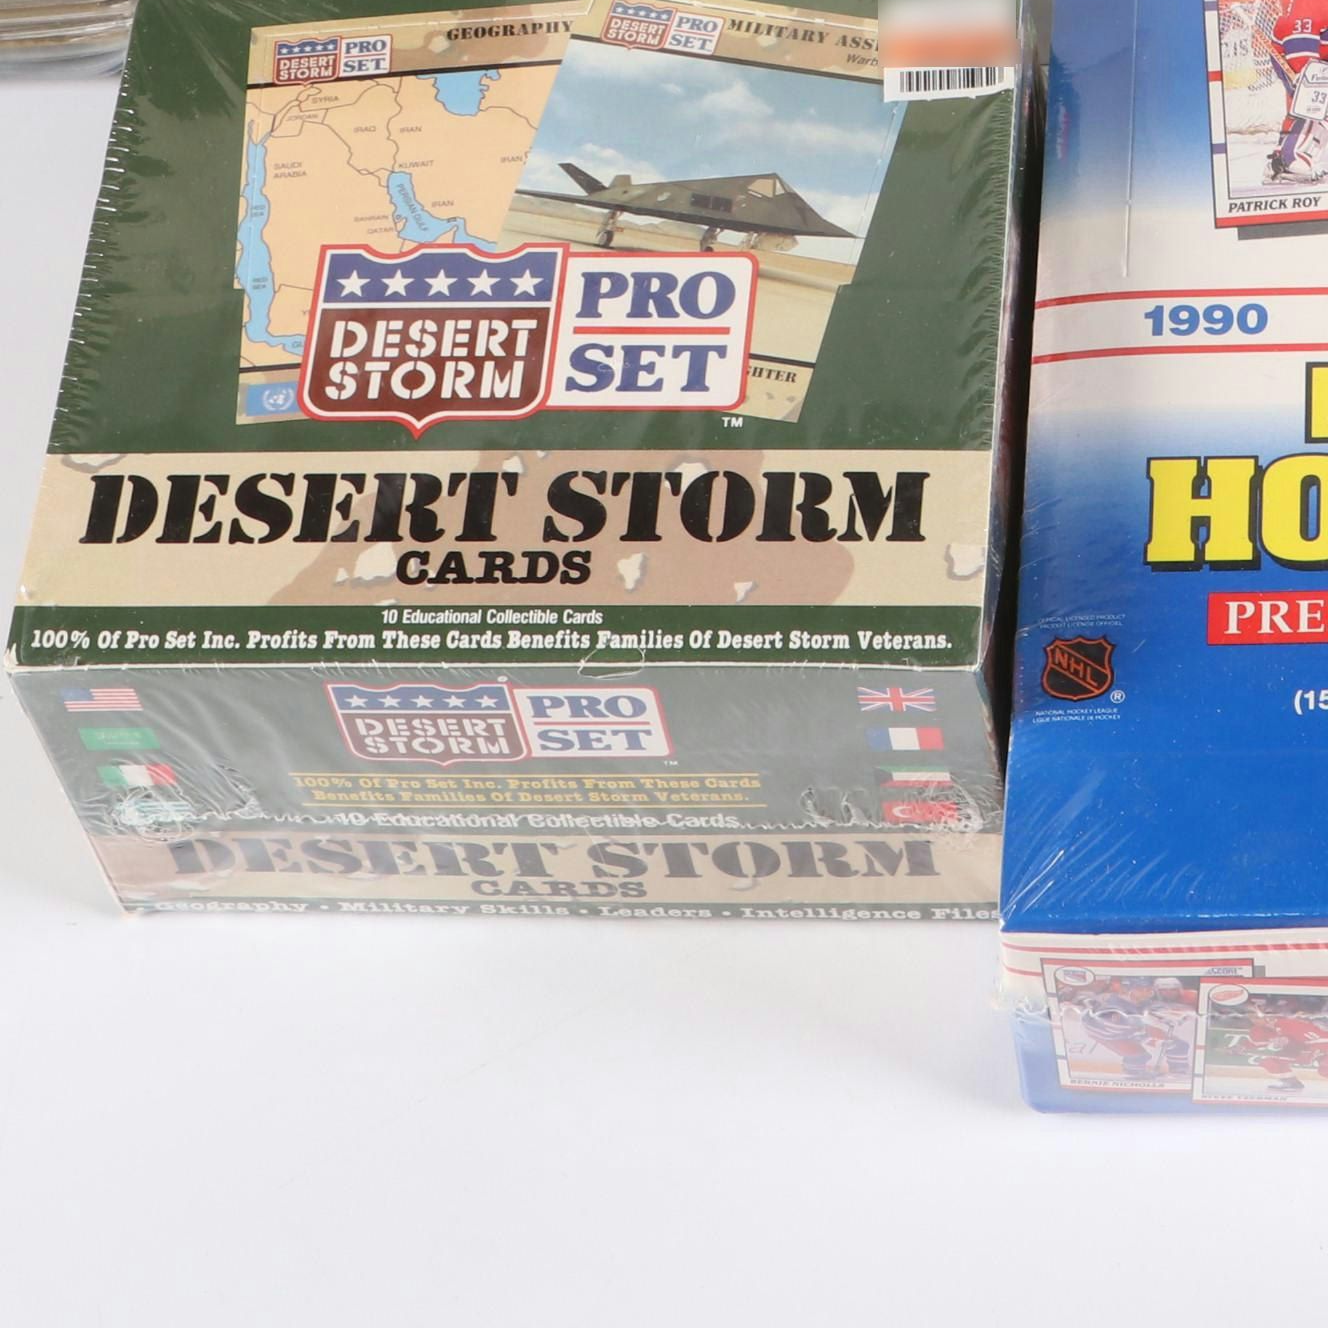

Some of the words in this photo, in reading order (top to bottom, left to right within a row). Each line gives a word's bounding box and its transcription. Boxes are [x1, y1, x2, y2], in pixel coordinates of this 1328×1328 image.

[446, 21, 574, 42] GEOGRAPHY
[609, 17, 667, 39] DESERT
[677, 15, 718, 34] PRO
[728, 19, 830, 46] MILITARY
[1292, 18, 1312, 34] 33
[343, 39, 387, 55] PRO
[607, 27, 660, 47] STORM
[669, 33, 713, 52] SET
[280, 54, 336, 70] DESERT
[342, 58, 386, 73] SET
[279, 66, 333, 81] STORM
[1228, 197, 1291, 214] PATRICK
[1293, 195, 1322, 210] ROY
[574, 271, 737, 321] PRO
[1144, 302, 1270, 337] 1990
[328, 319, 538, 360] DESERT
[565, 342, 729, 394] SET
[323, 359, 525, 402] STORM
[78, 471, 521, 546] DESERT
[542, 469, 932, 544] STORM
[395, 549, 593, 586] CARDS
[381, 610, 398, 626] 10
[402, 608, 482, 626] Educational
[486, 608, 559, 626] Collectible
[563, 609, 603, 626] Cards
[31, 629, 91, 650] 100%
[97, 629, 122, 650] Of
[124, 629, 161, 650] Pro
[164, 629, 197, 650] Set
[202, 629, 242, 650] Inc.
[246, 629, 318, 650] Profits
[322, 629, 376, 650] From
[382, 629, 441, 650] These
[446, 629, 502, 650] Cards
[506, 629, 591, 650] Benefits
[596, 629, 684, 650] Families
[689, 629, 715, 650] Of
[716, 629, 784, 650] Desert
[789, 629, 850, 650] Storm
[857, 629, 954, 650] Veterans.
[1055, 647, 1099, 687] NHL
[526, 694, 648, 719] PRO
[355, 717, 508, 738] DESERT
[363, 735, 512, 756] STORM
[534, 728, 654, 752] SET
[168, 838, 560, 878] DESERT
[586, 840, 942, 879] STORM
[470, 879, 648, 899] CARDS
[338, 901, 476, 916] Military
[480, 903, 569, 916] Skills
[598, 905, 712, 918] Leaders
[740, 906, 922, 921] Intelligence
